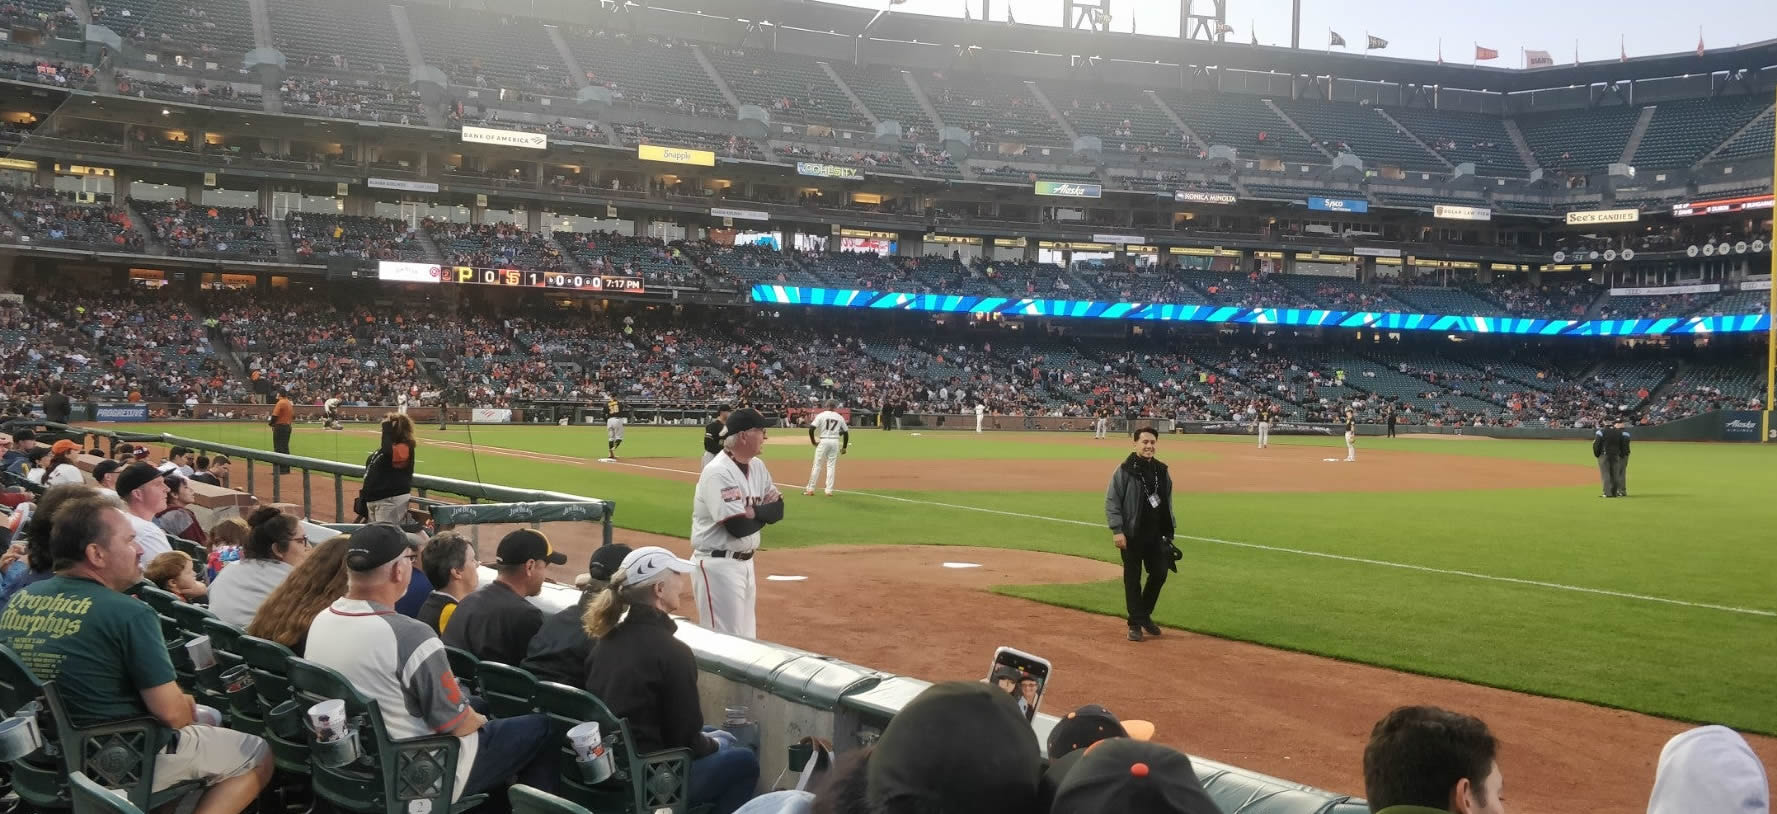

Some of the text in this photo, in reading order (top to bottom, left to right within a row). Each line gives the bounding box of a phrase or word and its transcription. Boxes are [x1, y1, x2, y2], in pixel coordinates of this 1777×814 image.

[463, 132, 483, 140] BANK
[496, 135, 529, 144] AMERICA
[663, 149, 691, 160] Snapple
[803, 162, 857, 177] COHESITY
[1053, 184, 1085, 196] Alaska
[1184, 192, 1237, 203] KONICA MINOLTA
[1324, 198, 1344, 208] Sysco
[1569, 212, 1633, 223] See's CANDIES
[458, 267, 473, 283] P
[484, 270, 495, 283] 0
[529, 273, 537, 286] 1
[574, 276, 583, 287] 0
[592, 277, 601, 288] 0
[605, 279, 640, 289] 7:17 PM
[96, 408, 145, 417] PROGRESSIVE
[825, 418, 839, 431] 17
[1725, 419, 1757, 429] Alaska
[1769, 429, 1777, 438] 3
[8, 590, 93, 615] Dropkick
[0, 608, 82, 639] Murphys
